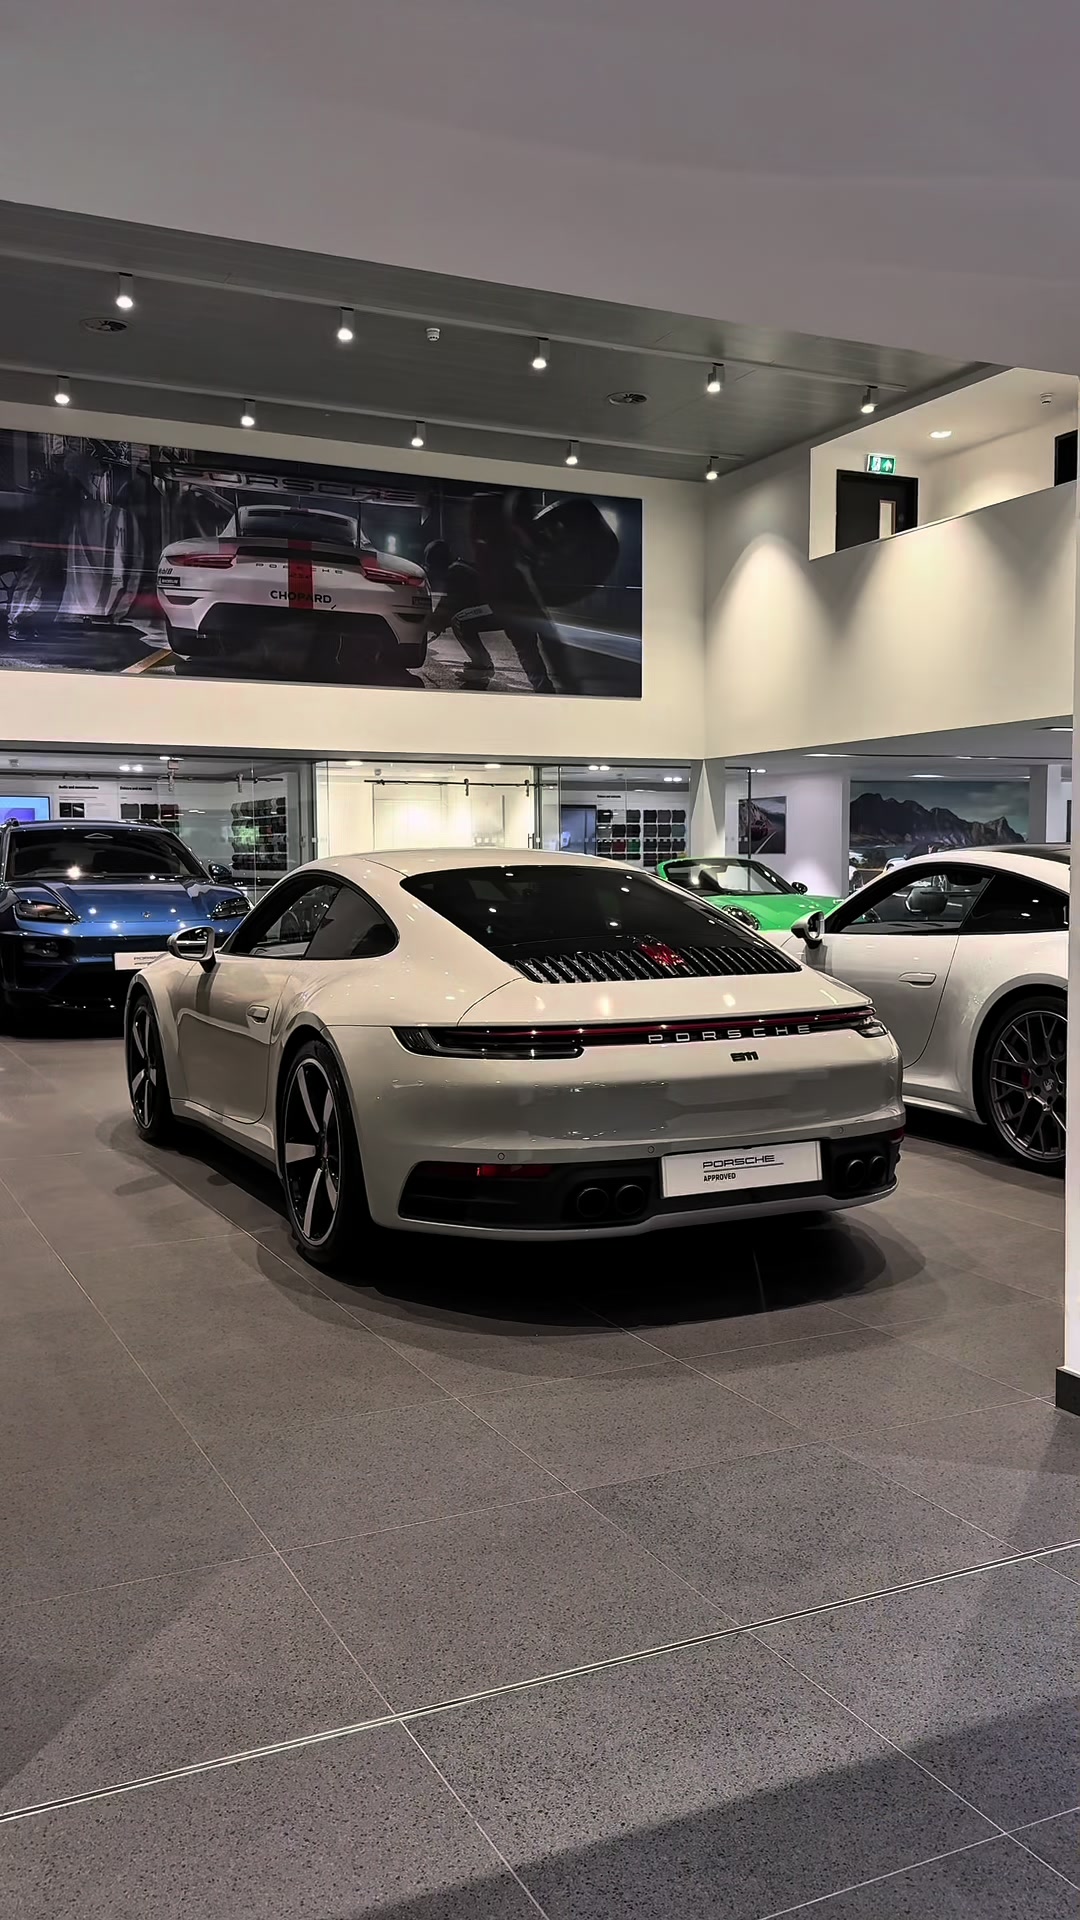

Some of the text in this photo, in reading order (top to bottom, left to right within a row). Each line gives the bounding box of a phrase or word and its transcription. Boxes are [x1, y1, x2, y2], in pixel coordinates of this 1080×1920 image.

[255, 562, 343, 574] PORCHE
[270, 590, 332, 604] CHOPARD
[648, 1024, 811, 1044] PORSCHE
[703, 1155, 775, 1169] PORSCHE
[703, 1172, 736, 1182] APPROVED
